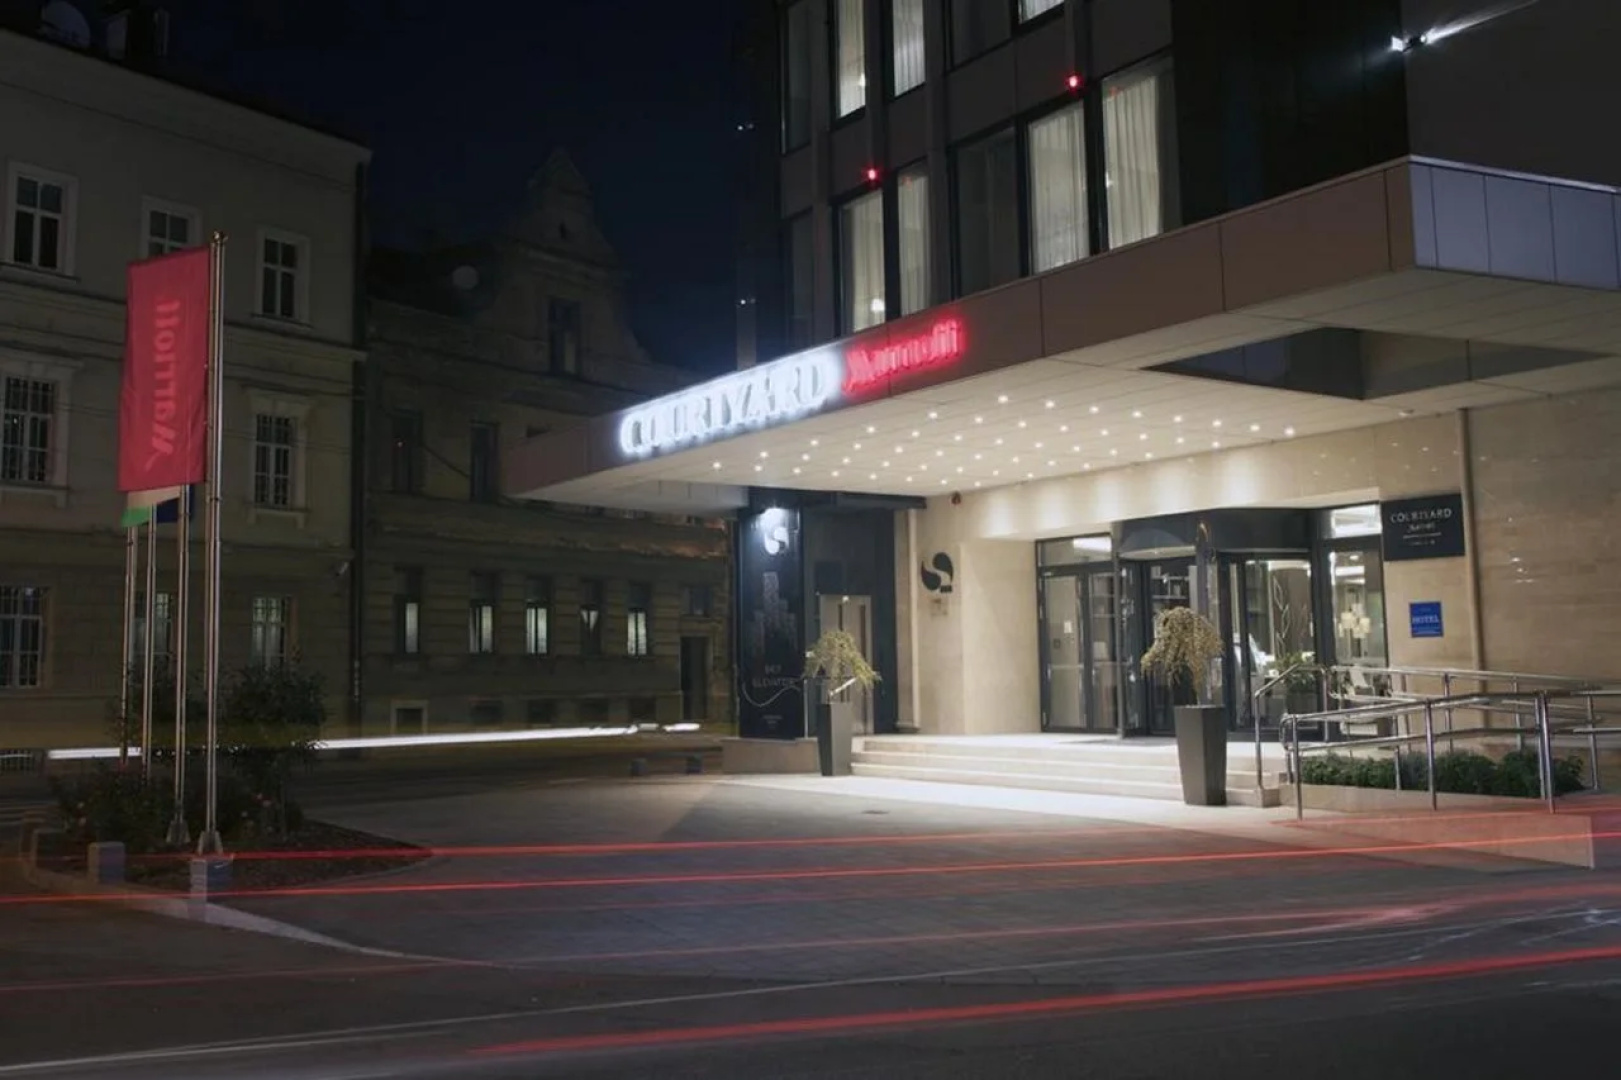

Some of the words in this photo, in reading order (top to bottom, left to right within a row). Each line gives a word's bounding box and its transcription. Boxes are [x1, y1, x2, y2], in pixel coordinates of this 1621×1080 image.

[621, 354, 837, 453] COURTYARD
[1390, 508, 1452, 523] COURTYARD
[1412, 614, 1440, 624] HOTEL
